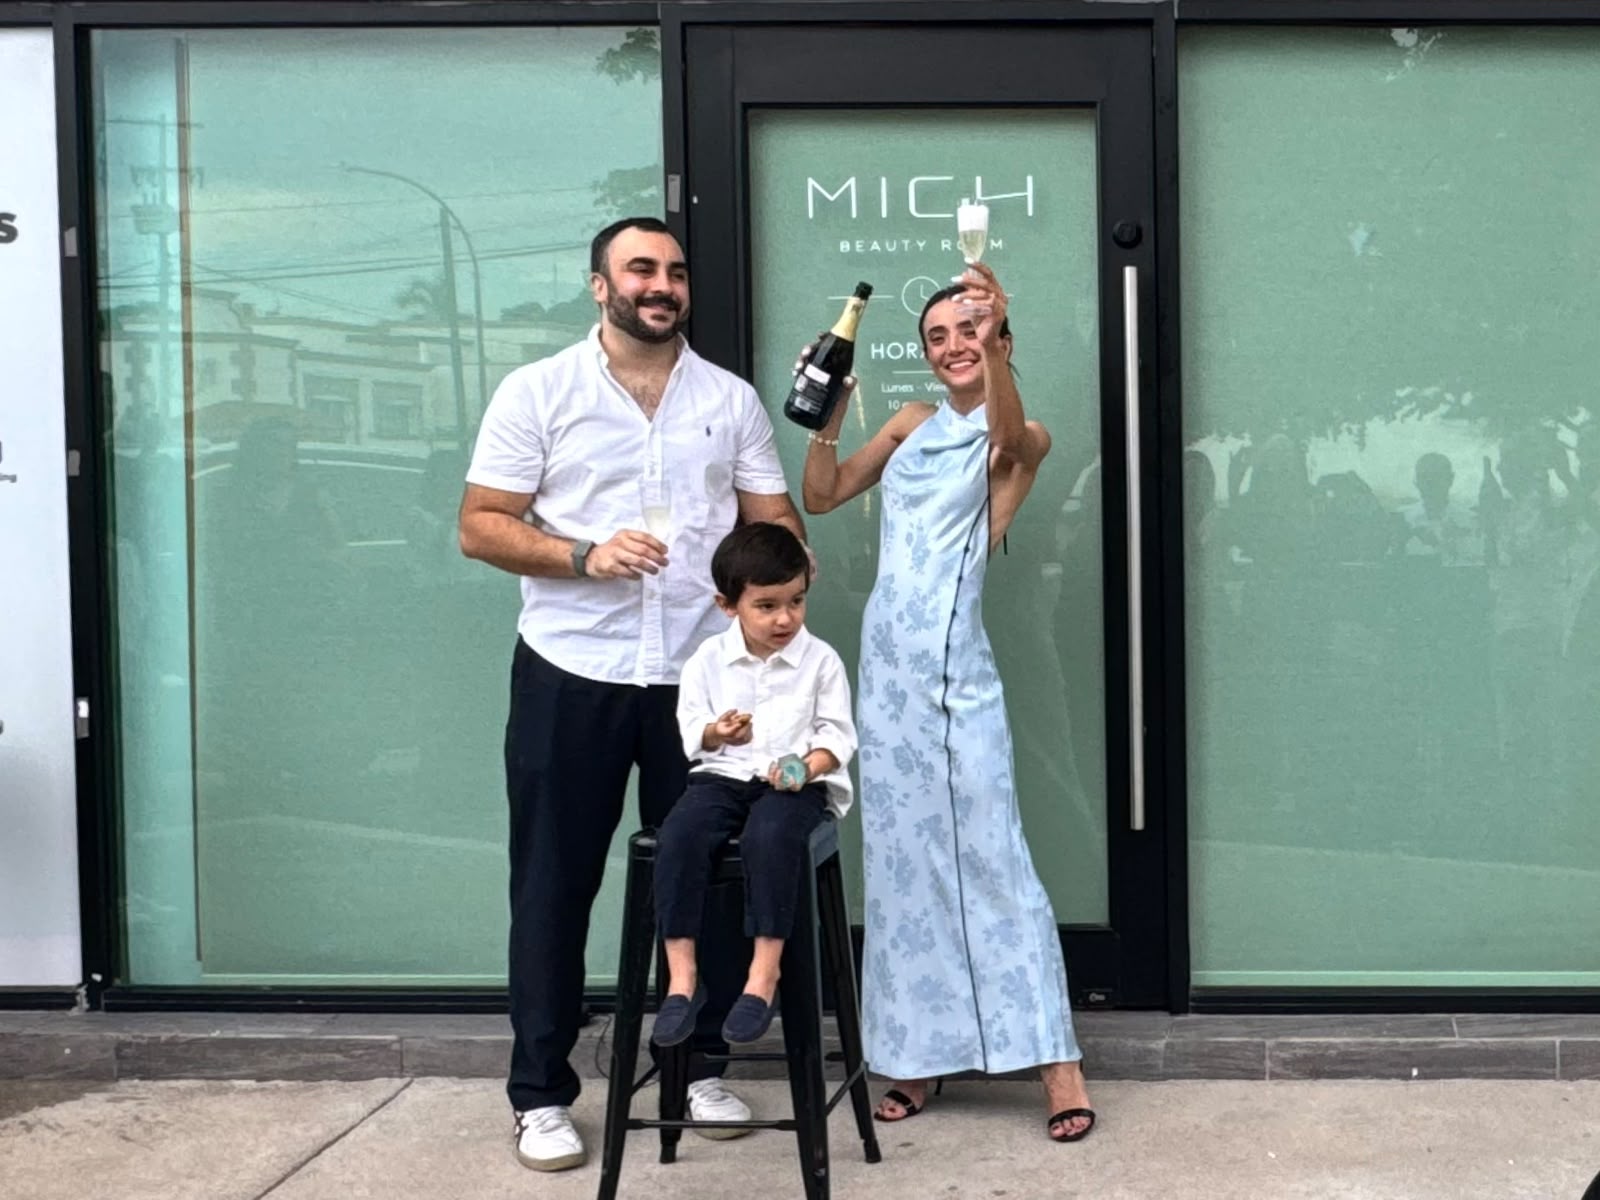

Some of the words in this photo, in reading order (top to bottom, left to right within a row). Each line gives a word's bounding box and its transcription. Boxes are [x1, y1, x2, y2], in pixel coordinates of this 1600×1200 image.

[807, 175, 1033, 219] MICH
[839, 239, 927, 253] BEAUTY
[941, 239, 1003, 251] RM
[871, 342, 925, 360] HOR
